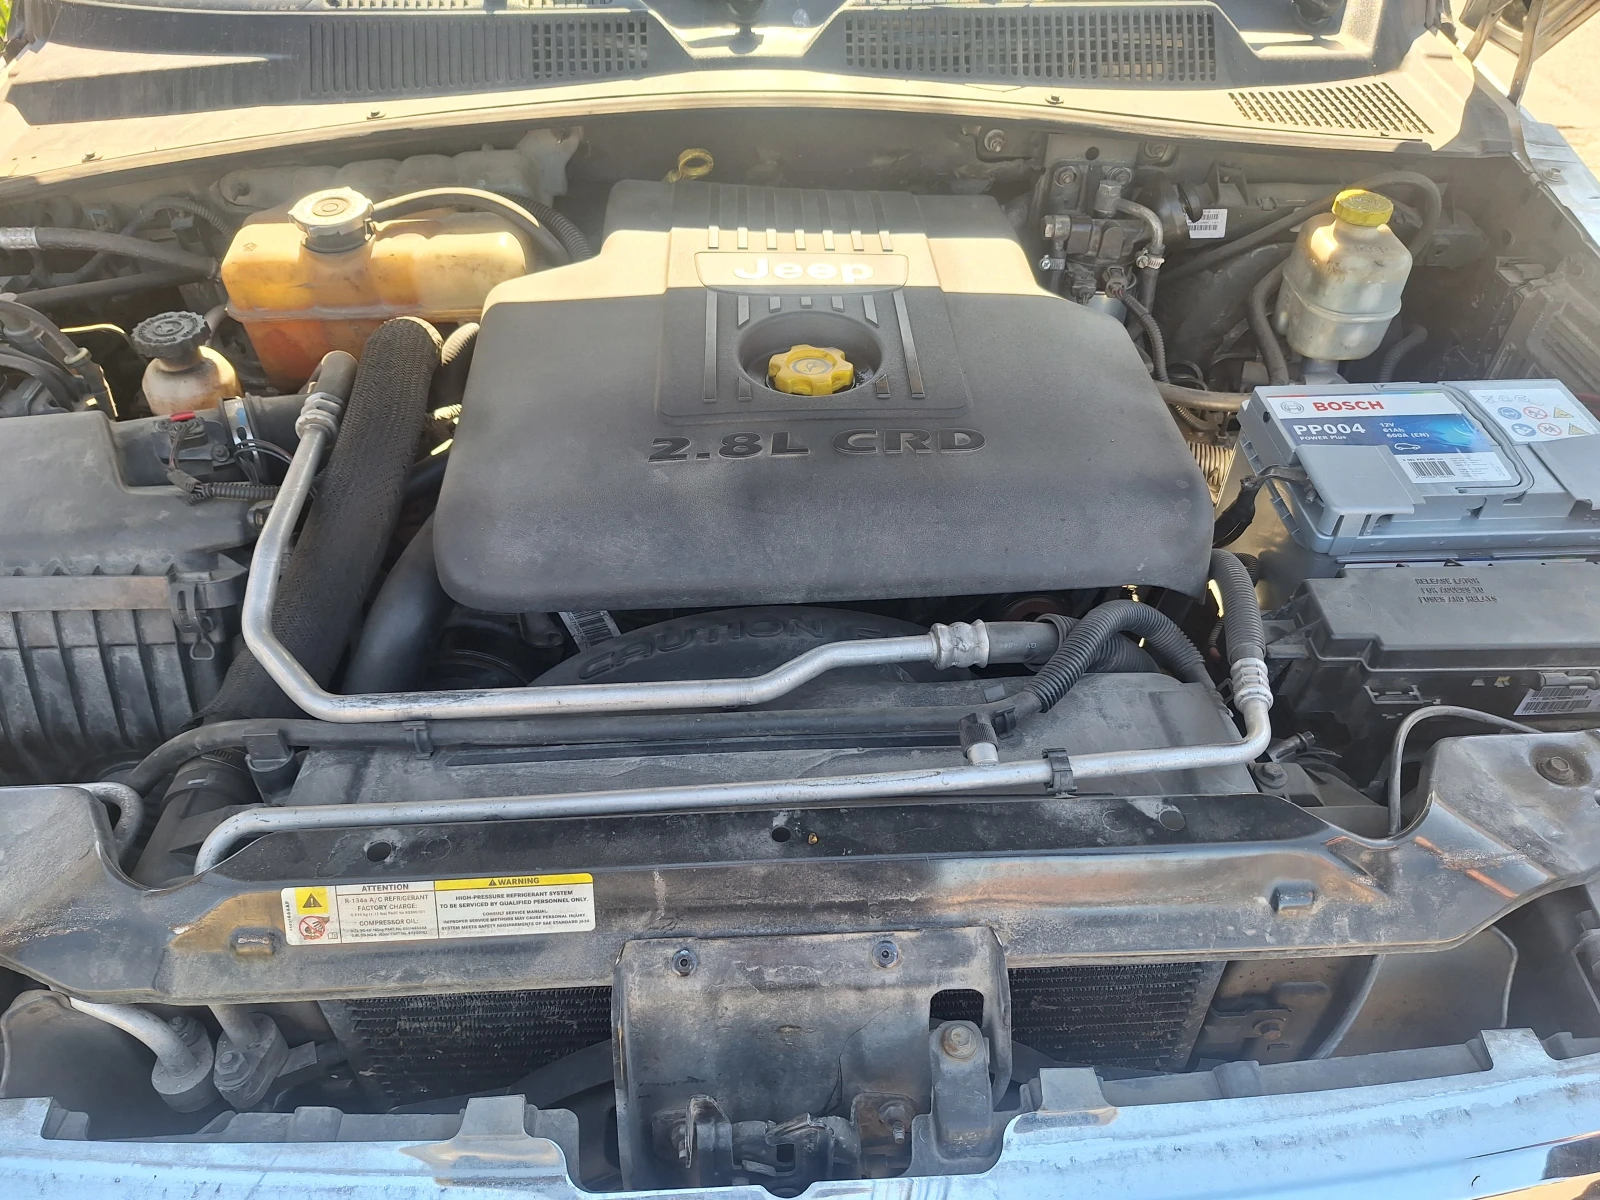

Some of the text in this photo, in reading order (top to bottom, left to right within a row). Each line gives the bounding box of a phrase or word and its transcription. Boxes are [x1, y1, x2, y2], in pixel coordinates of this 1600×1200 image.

[733, 258, 874, 284] Jeep
[1312, 400, 1385, 412] BOSCH
[1292, 423, 1366, 436] PP004
[648, 428, 987, 463] 2.8L CRD
[578, 617, 825, 680] CAUTION
[498, 877, 540, 886] WARNING
[361, 883, 409, 892] ATTENTION
[384, 894, 429, 902] REFRIGERANT
[455, 892, 505, 900] HIGH-PRESSURE
[506, 891, 547, 899] REFRIGERANT
[357, 903, 388, 911] FACTORY
